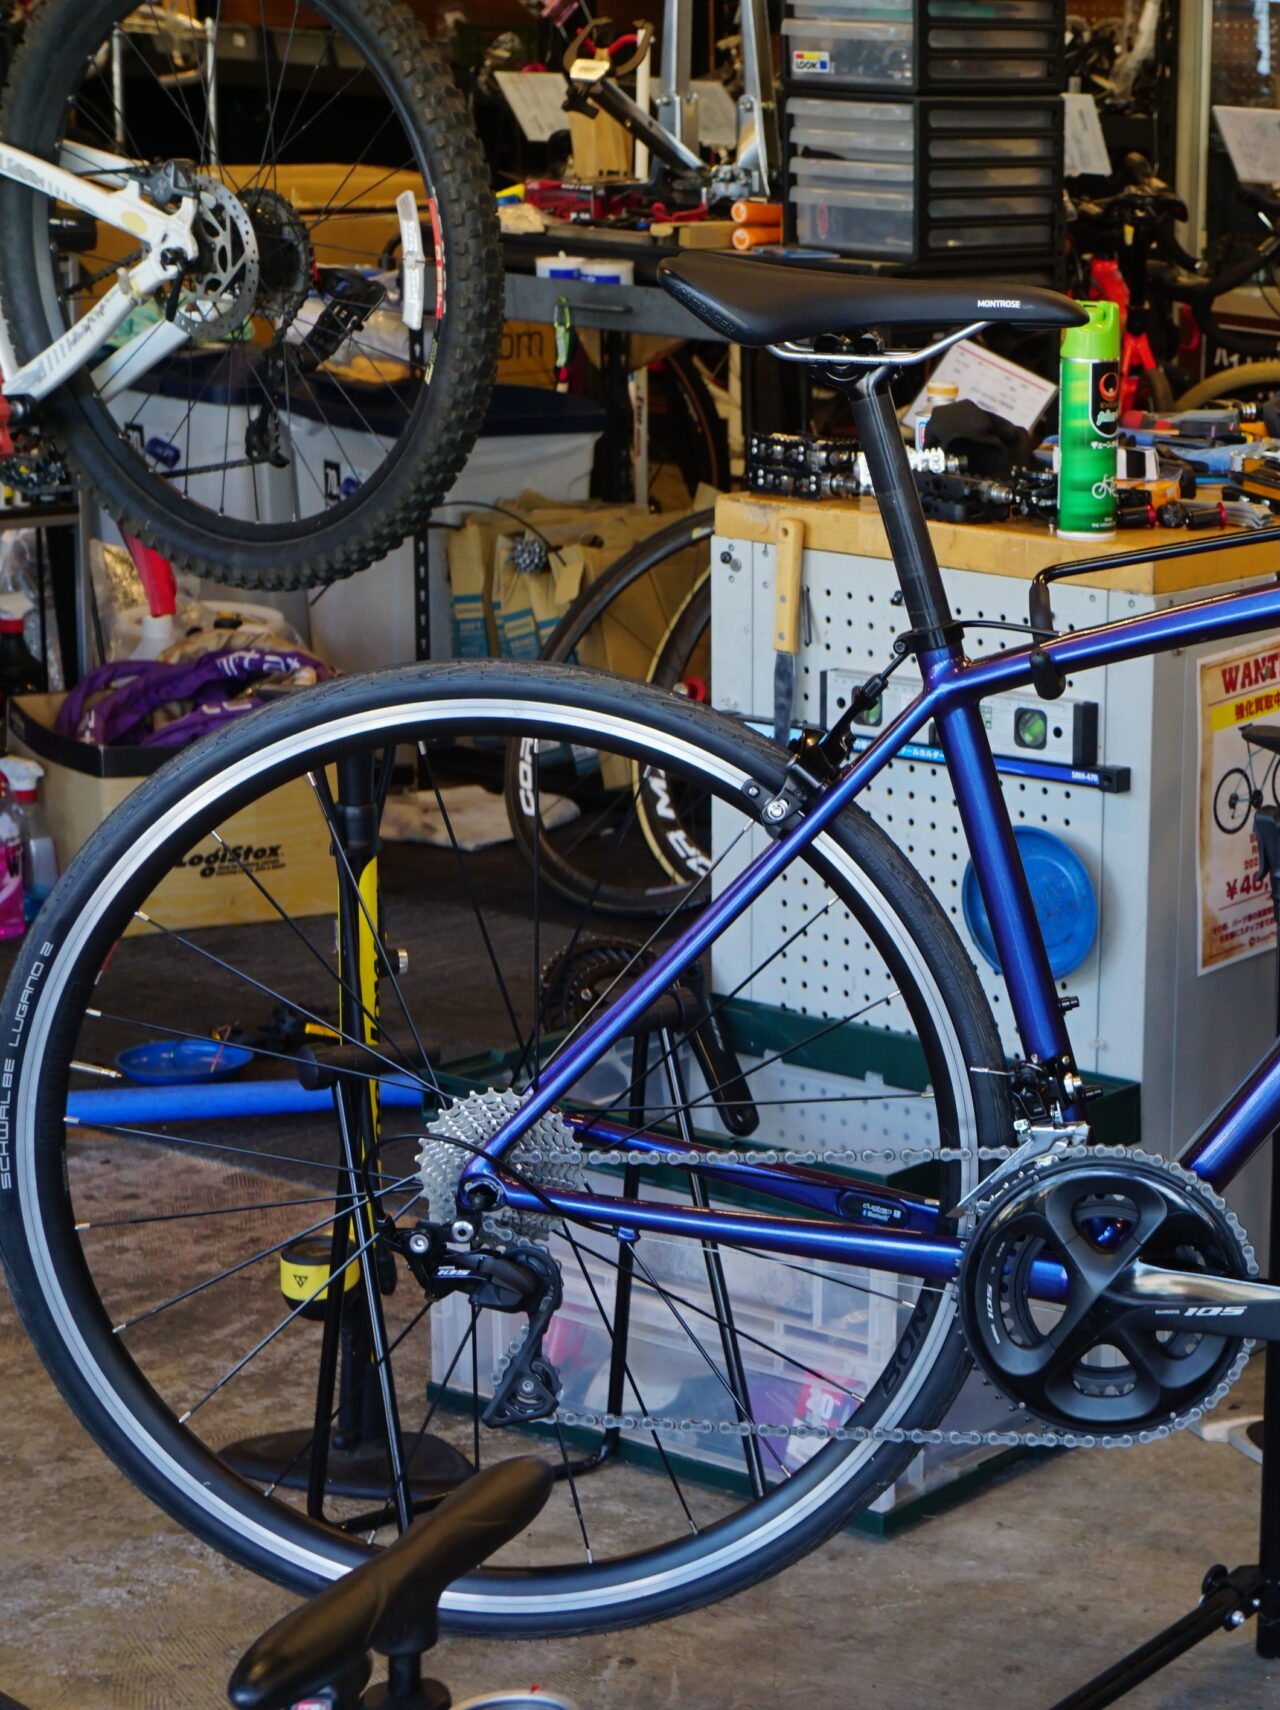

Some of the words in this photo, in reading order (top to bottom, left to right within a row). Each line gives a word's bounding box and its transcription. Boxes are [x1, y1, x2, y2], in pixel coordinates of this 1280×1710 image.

[977, 299, 1021, 309] MONTROSE
[0, 1058, 16, 1190] SCHWALBE
[8, 961, 45, 1048] LUGANO
[40, 941, 54, 957] 2
[1184, 1306, 1248, 1317] 105
